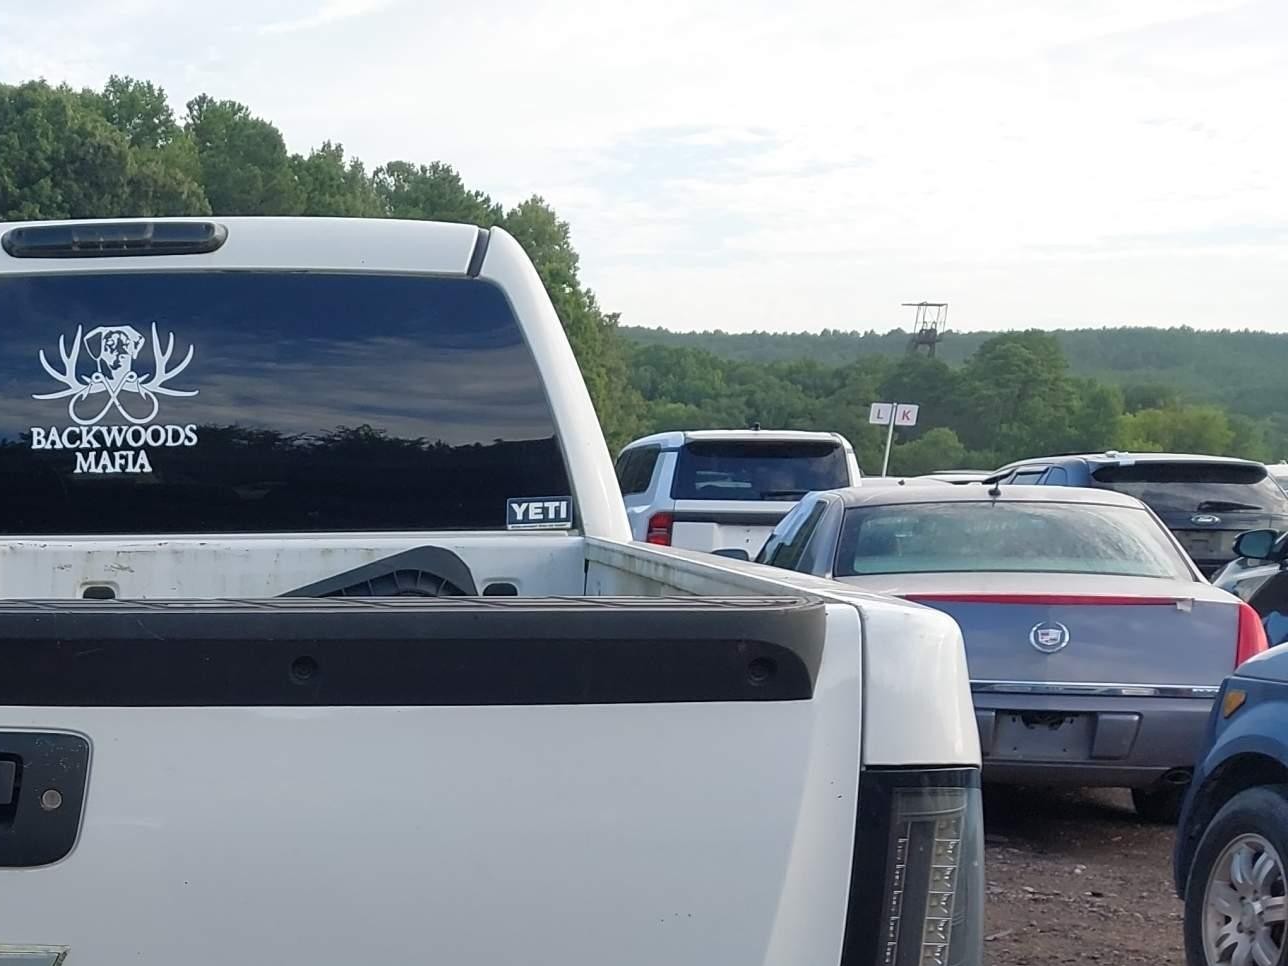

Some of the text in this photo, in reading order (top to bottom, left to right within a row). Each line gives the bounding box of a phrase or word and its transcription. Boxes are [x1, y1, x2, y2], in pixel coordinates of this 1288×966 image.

[876, 408, 884, 420] L
[902, 409, 911, 421] K
[30, 424, 199, 449] BACKWOODS
[72, 449, 153, 474] MAFIA
[510, 501, 568, 520] YETI
